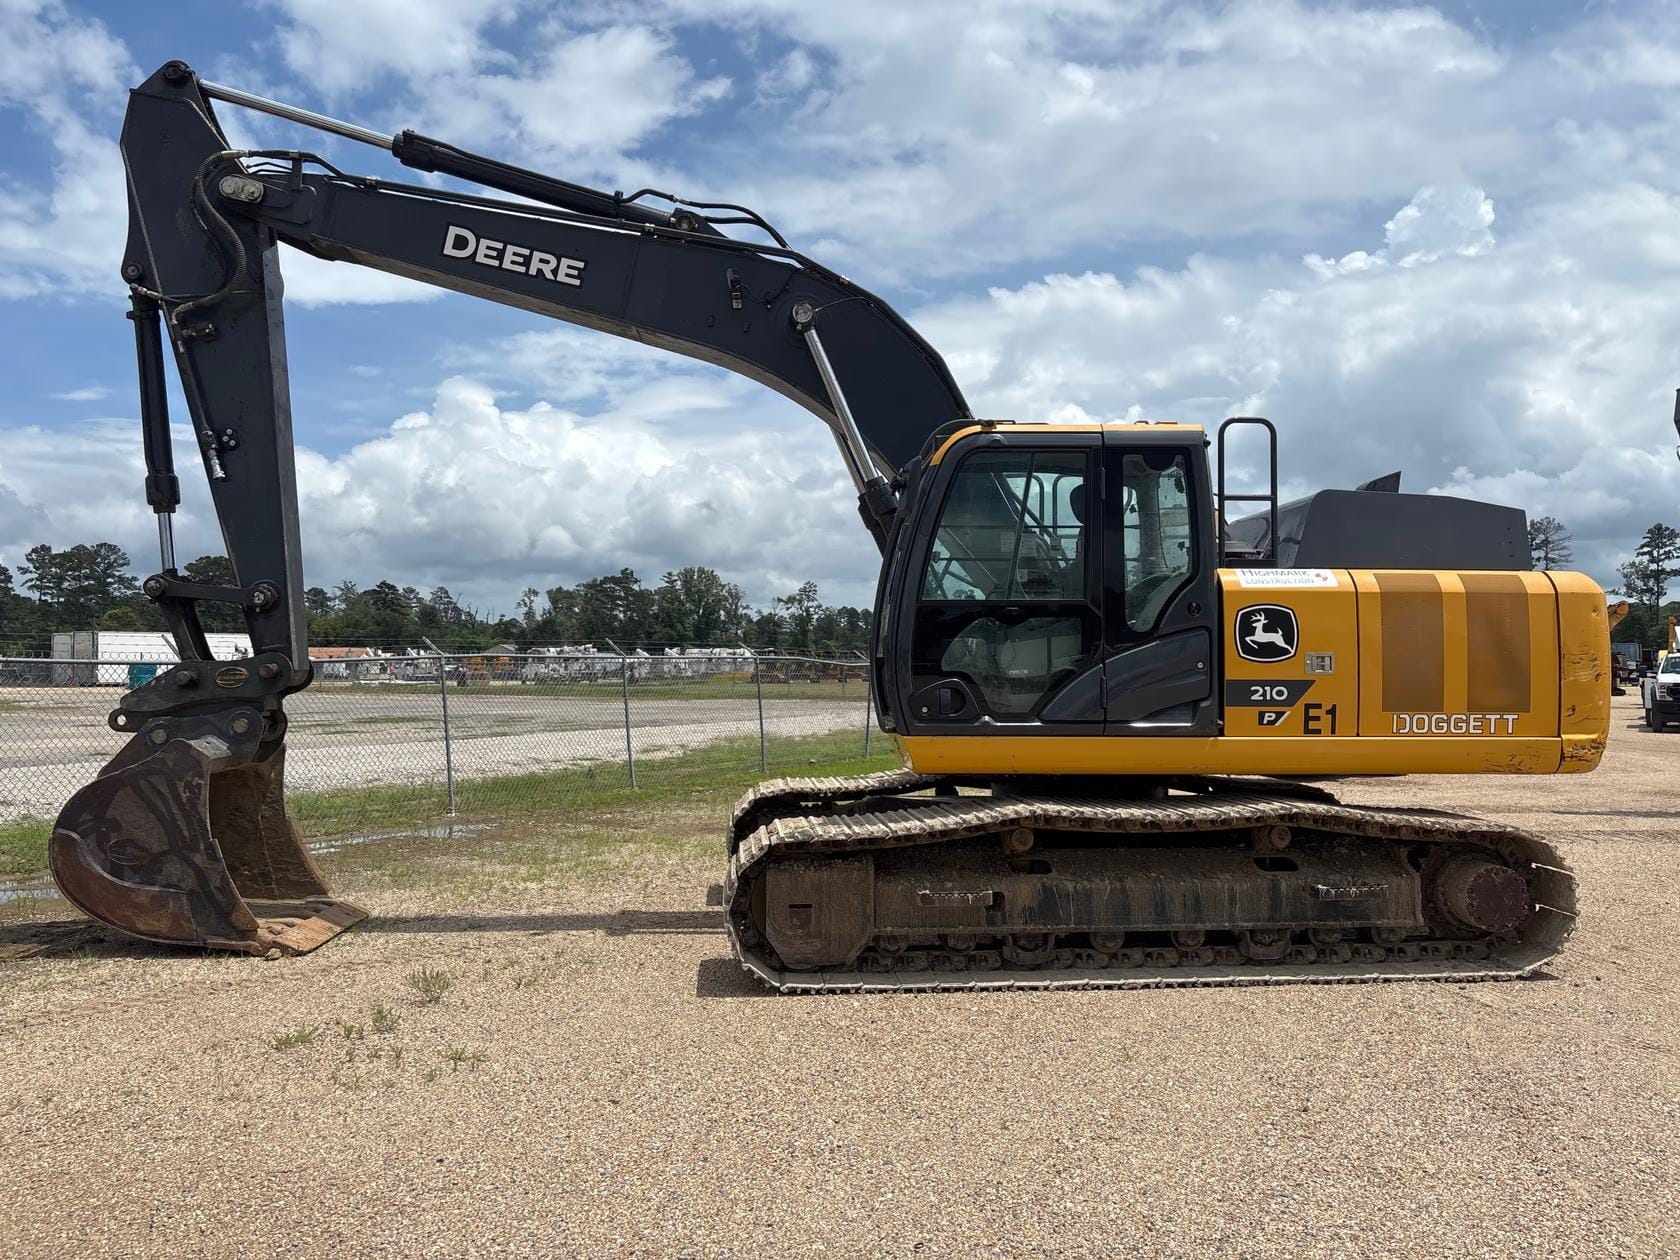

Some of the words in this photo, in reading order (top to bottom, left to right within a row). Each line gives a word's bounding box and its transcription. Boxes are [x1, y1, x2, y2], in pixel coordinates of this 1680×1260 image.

[442, 224, 586, 287] DEERE
[1240, 568, 1310, 577] HIGHMARK
[1245, 577, 1315, 585] CONSTRUCTION
[1249, 685, 1289, 701] 210
[1262, 712, 1277, 725] P
[1302, 702, 1338, 736] E1
[1392, 713, 1519, 734] DOGGETT
